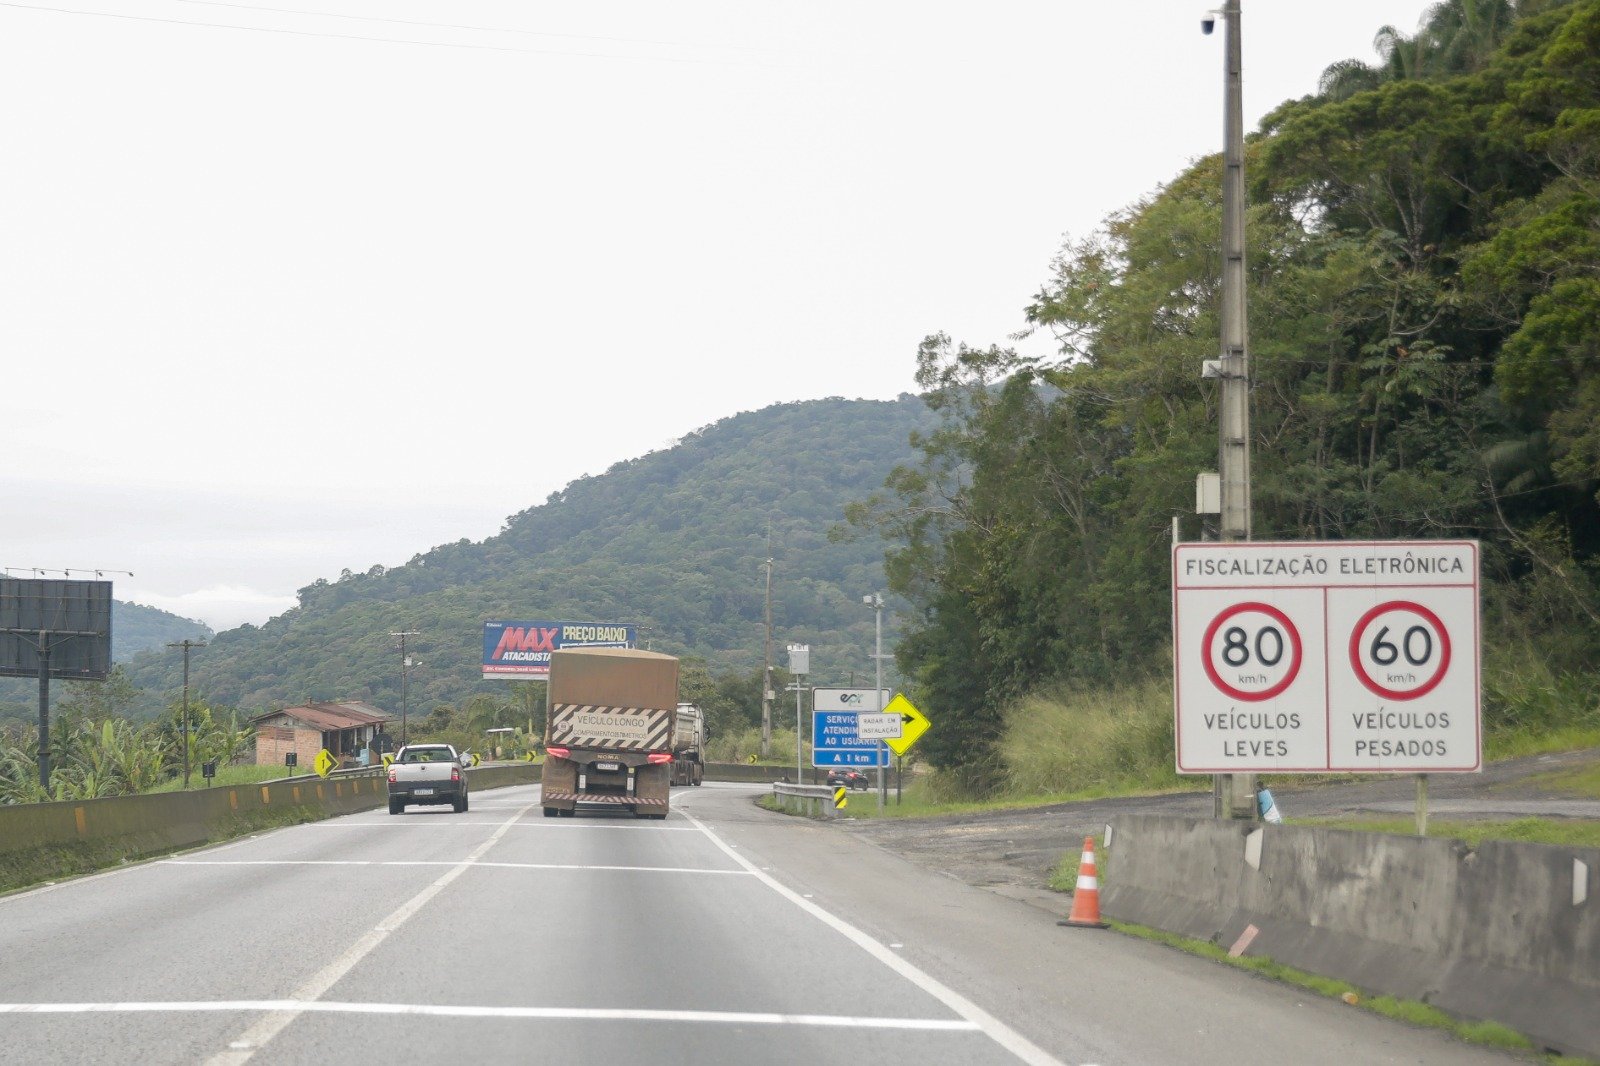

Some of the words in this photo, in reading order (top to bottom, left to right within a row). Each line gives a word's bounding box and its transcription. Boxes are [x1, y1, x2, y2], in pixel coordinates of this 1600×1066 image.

[1186, 555, 1328, 577] FISCALIZAÇÃO
[1340, 552, 1464, 575] ELETRÔNICA
[492, 627, 558, 659] MAX
[563, 626, 595, 643] PREÇO
[597, 626, 626, 641] BAIXO
[1221, 626, 1284, 668] 80
[1370, 625, 1432, 666] 60
[1238, 673, 1267, 684] km/h
[1387, 672, 1416, 683] km/h
[615, 717, 645, 728] LONGO
[1204, 707, 1301, 730] VEÍCULOS
[1352, 706, 1450, 729] VEÍCULOS
[862, 726, 898, 734] INSTALAÇÃO
[825, 737, 836, 745] AO
[1224, 741, 1288, 757] LEVES
[1355, 740, 1447, 757] PESADOS
[833, 753, 841, 762] A
[846, 753, 851, 762] 1
[855, 754, 869, 762] km
